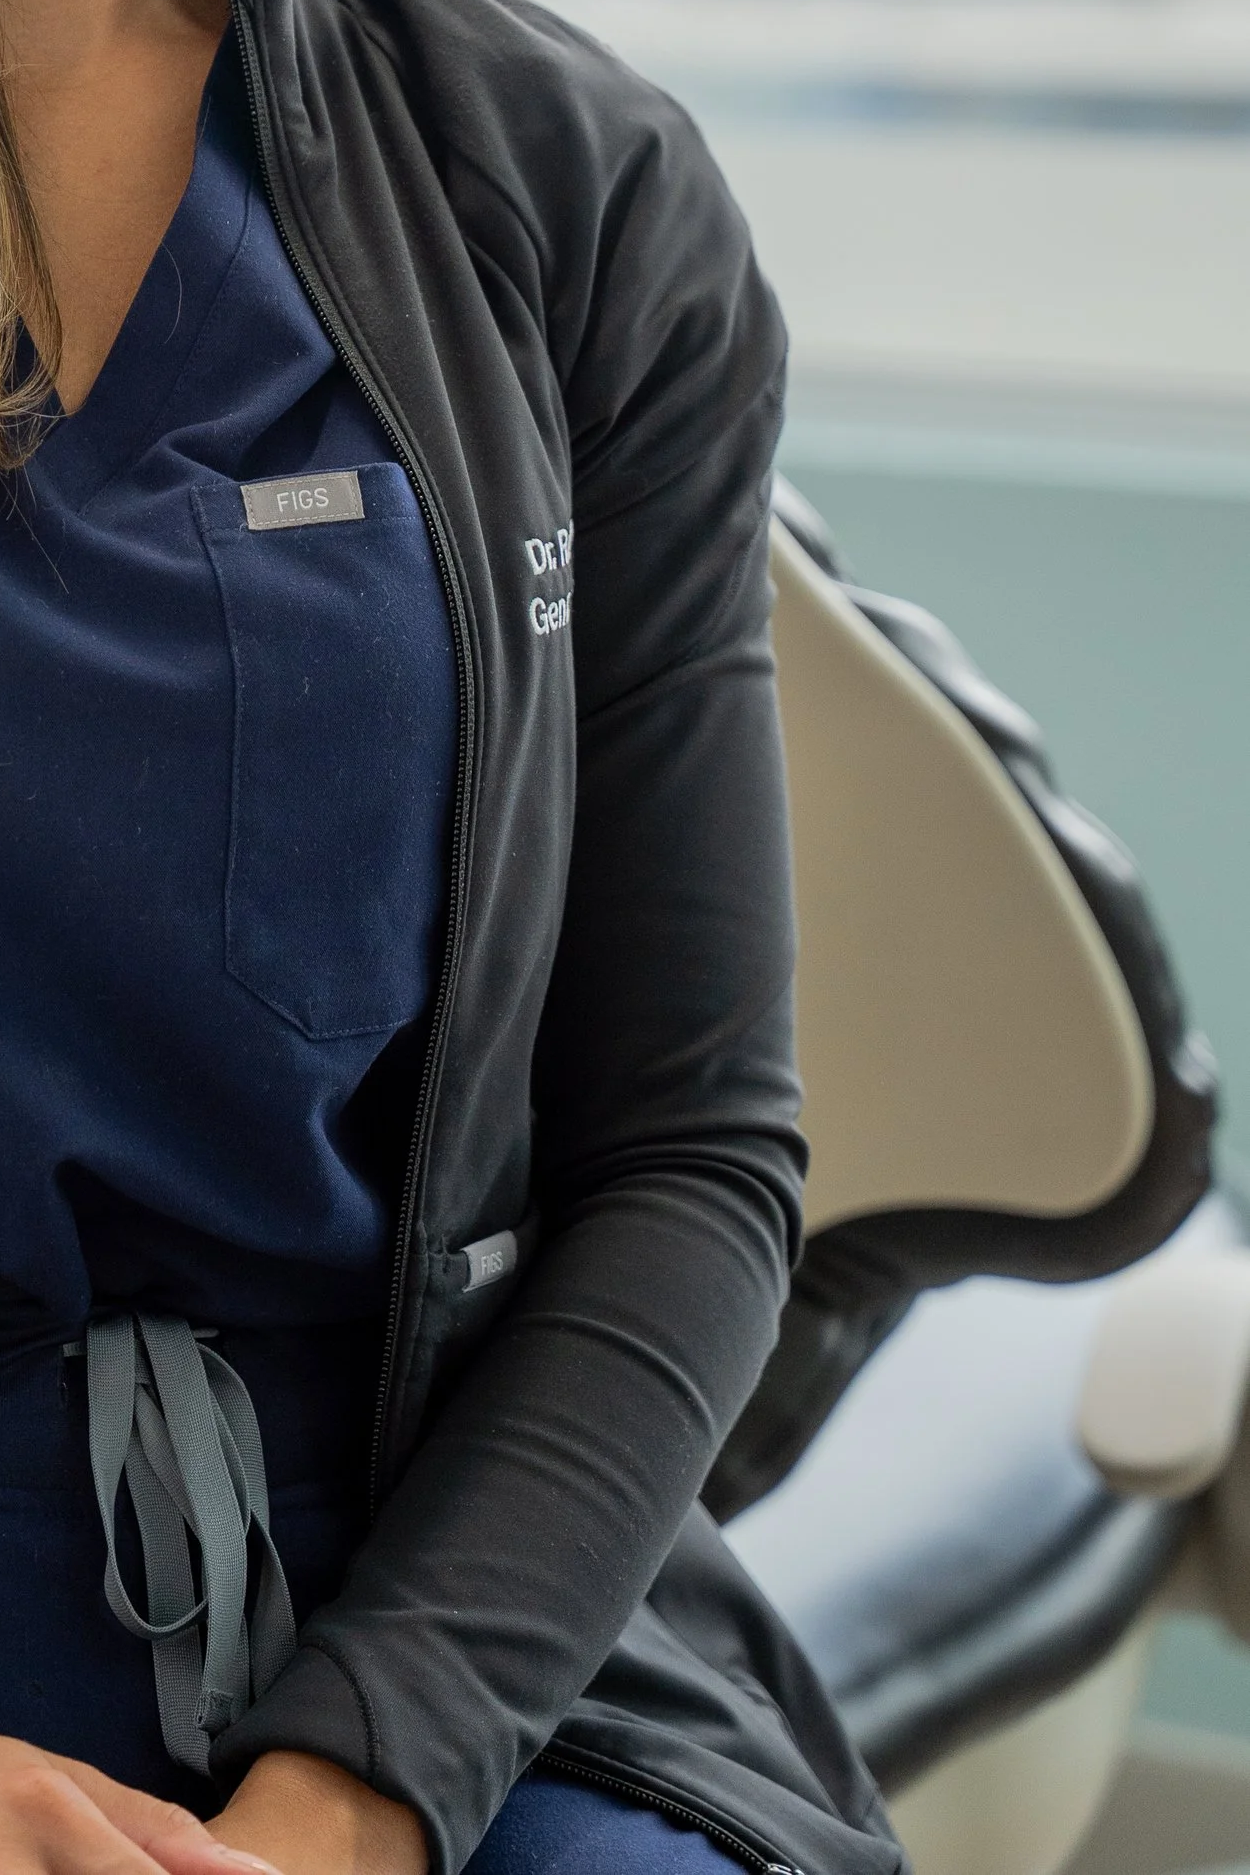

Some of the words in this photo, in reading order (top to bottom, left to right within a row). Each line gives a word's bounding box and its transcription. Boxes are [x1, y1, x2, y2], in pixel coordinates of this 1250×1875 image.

[276, 487, 329, 513] FIGS
[525, 538, 557, 575] Dr.
[481, 1251, 504, 1275] FIGS
